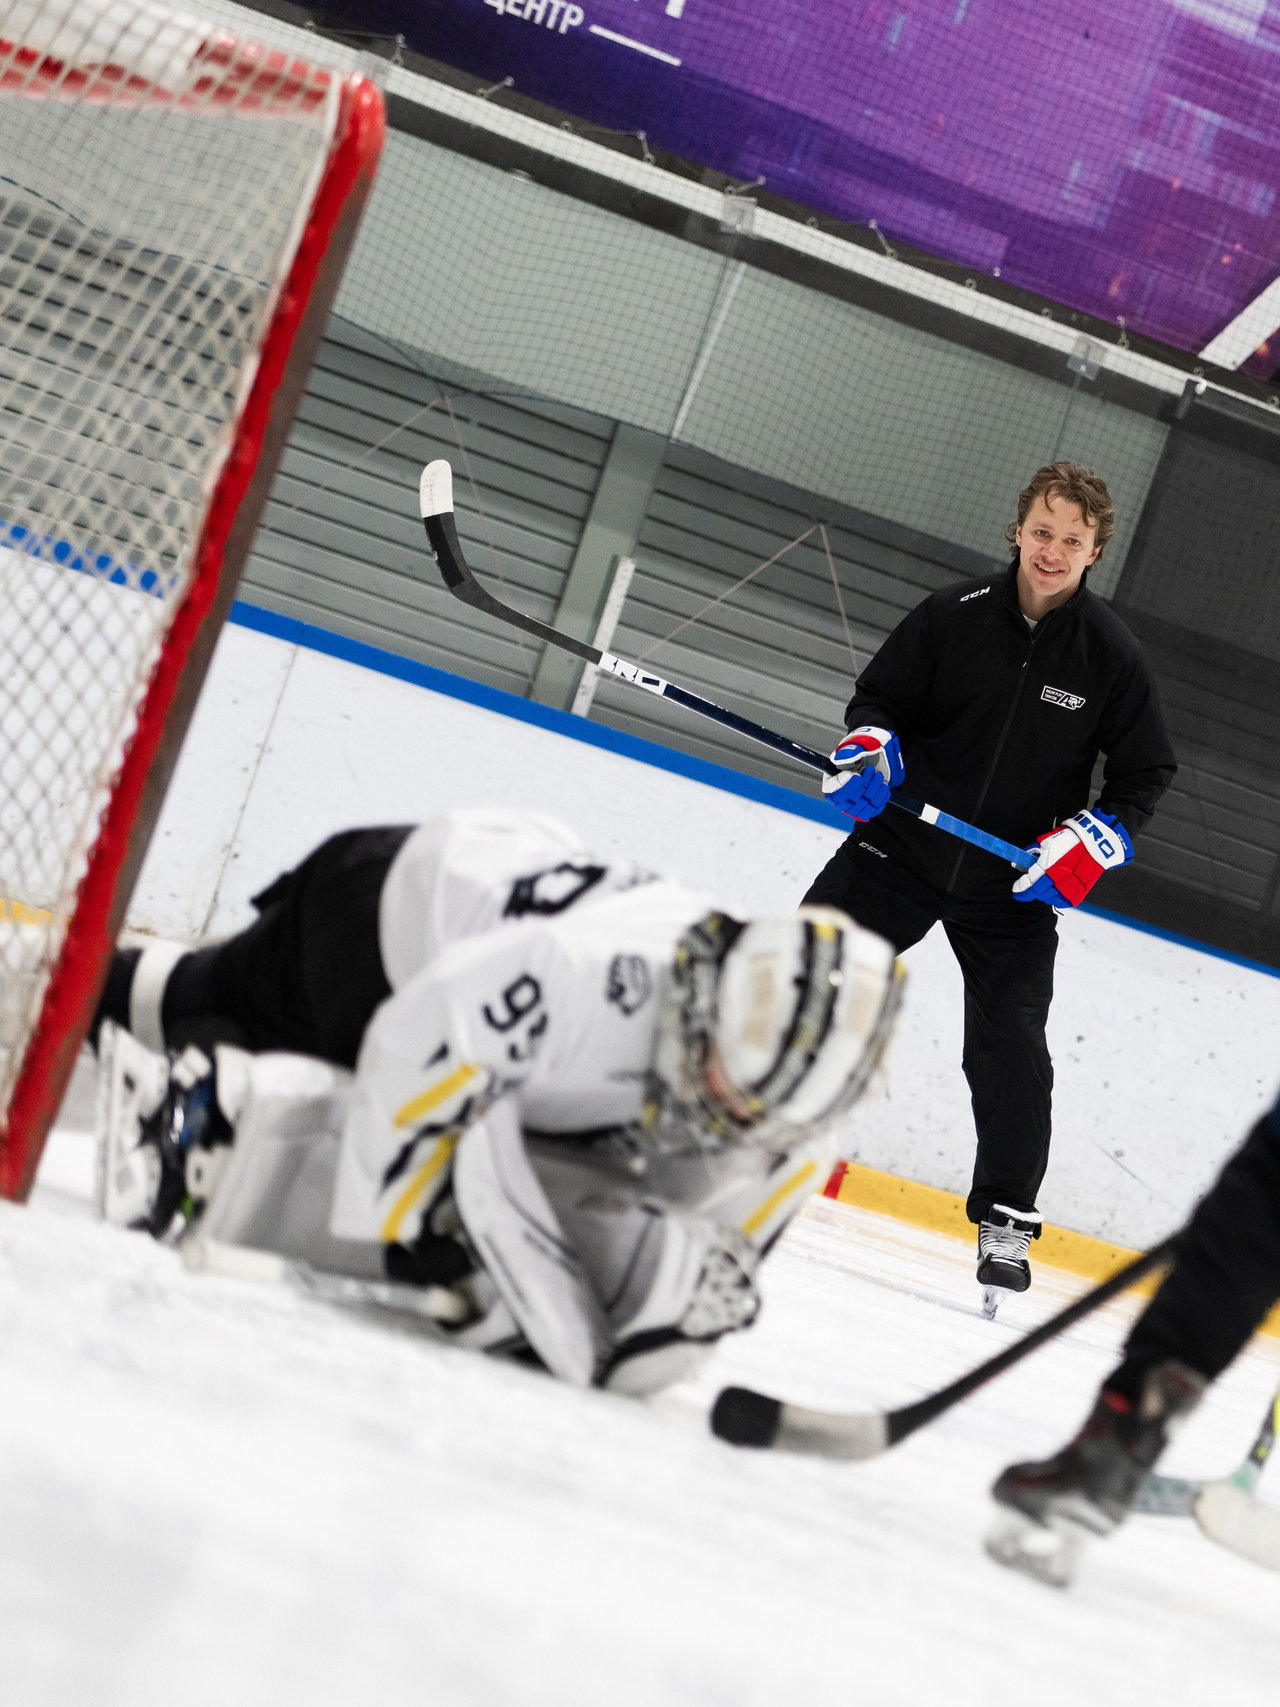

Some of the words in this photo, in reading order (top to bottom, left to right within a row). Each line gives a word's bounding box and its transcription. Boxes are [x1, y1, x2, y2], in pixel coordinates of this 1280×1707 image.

[484, 0, 585, 35] ЕНТР
[959, 586, 991, 602] CCM
[858, 840, 888, 859] CCM
